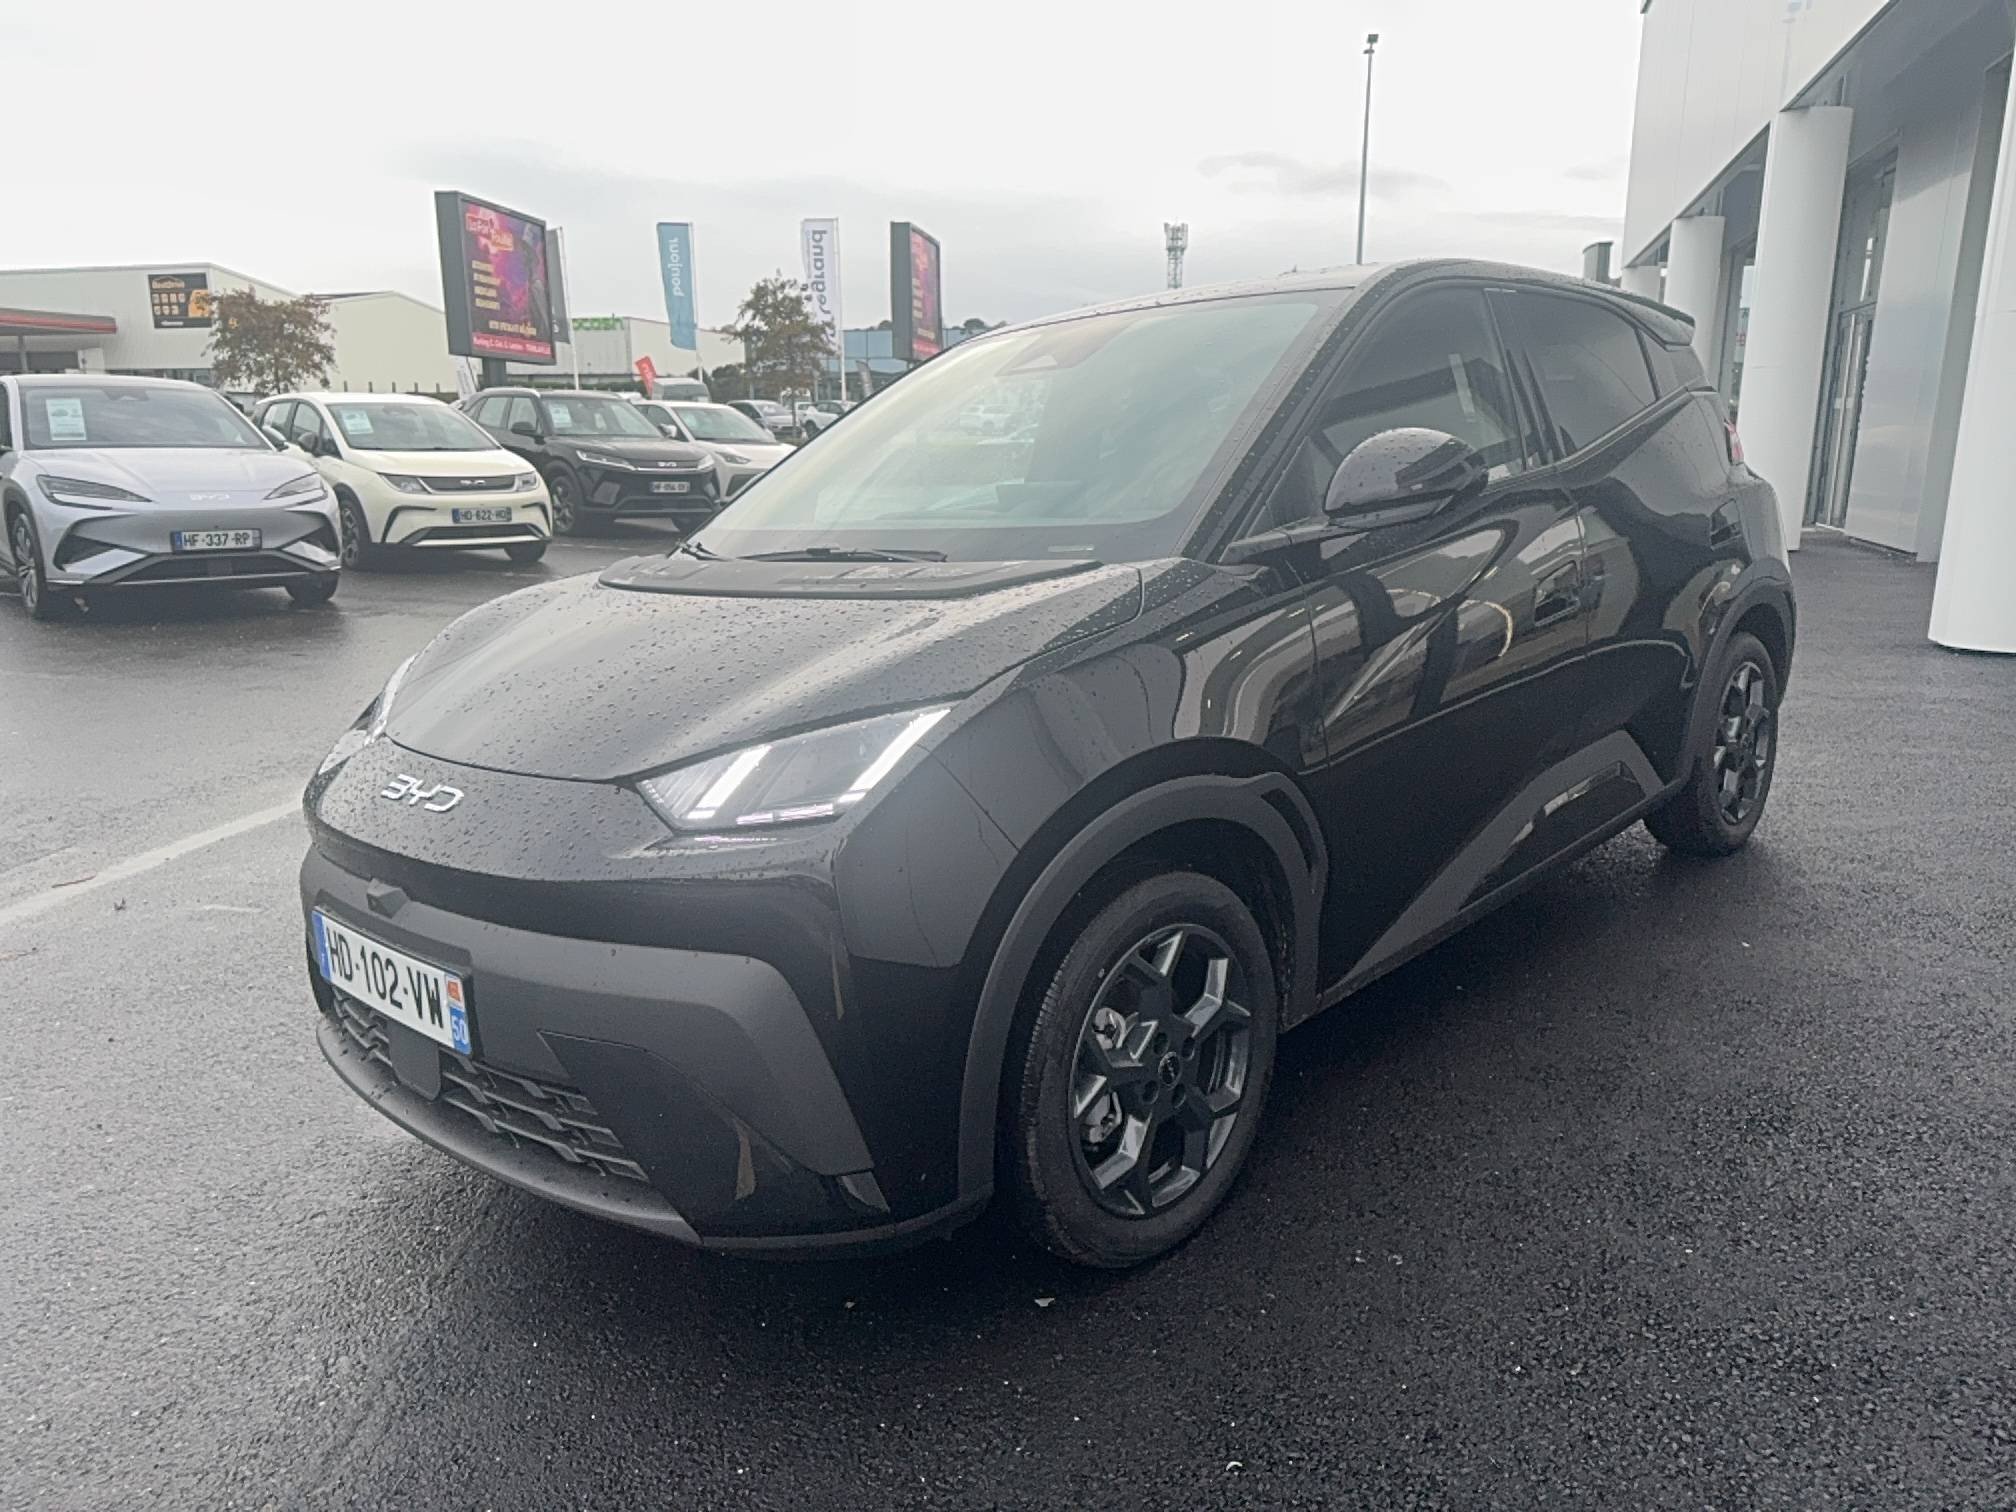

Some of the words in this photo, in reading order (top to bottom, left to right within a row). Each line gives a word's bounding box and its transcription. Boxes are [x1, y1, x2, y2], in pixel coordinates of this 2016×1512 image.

[183, 532, 250, 547] HF-337-RP
[381, 773, 465, 813] BYD
[326, 926, 444, 1030] HD-102-VW
[451, 1014, 468, 1044] 50
